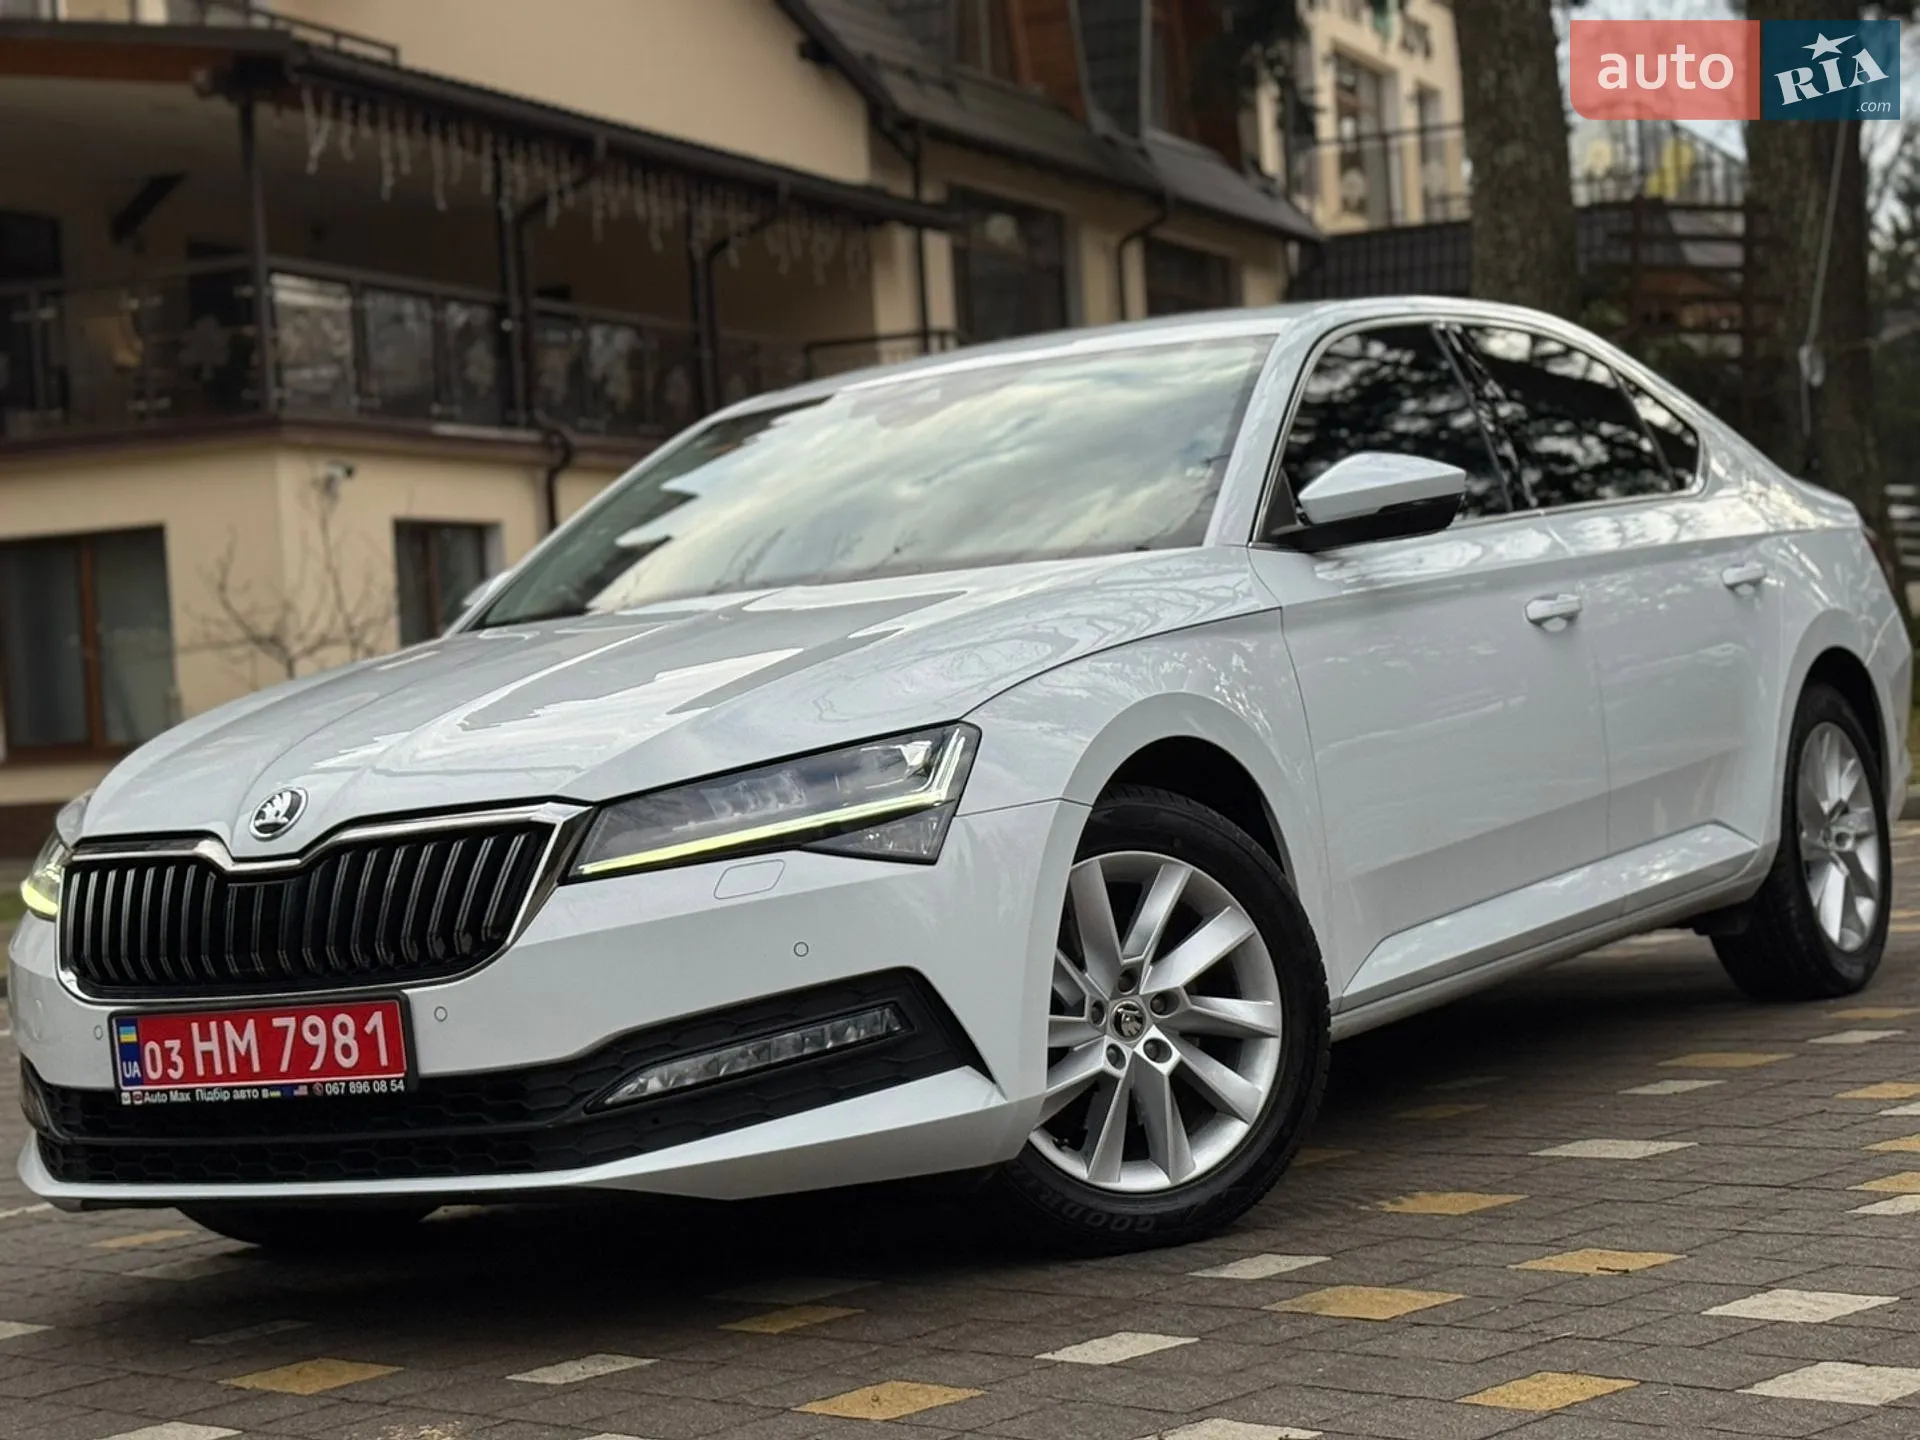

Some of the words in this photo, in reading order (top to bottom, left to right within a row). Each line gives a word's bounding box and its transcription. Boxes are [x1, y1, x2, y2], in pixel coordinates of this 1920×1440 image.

[144, 1039, 185, 1080] 03
[191, 1019, 261, 1076] HM
[272, 1010, 389, 1073] 7981
[122, 1061, 141, 1079] UA
[144, 1091, 168, 1103] Auto
[169, 1090, 191, 1102] Max
[195, 1088, 231, 1102] Підбір
[232, 1088, 260, 1100] авто
[325, 1082, 346, 1095] 067
[349, 1080, 370, 1094] 896
[373, 1080, 388, 1093] 08
[390, 1079, 405, 1092] 54
